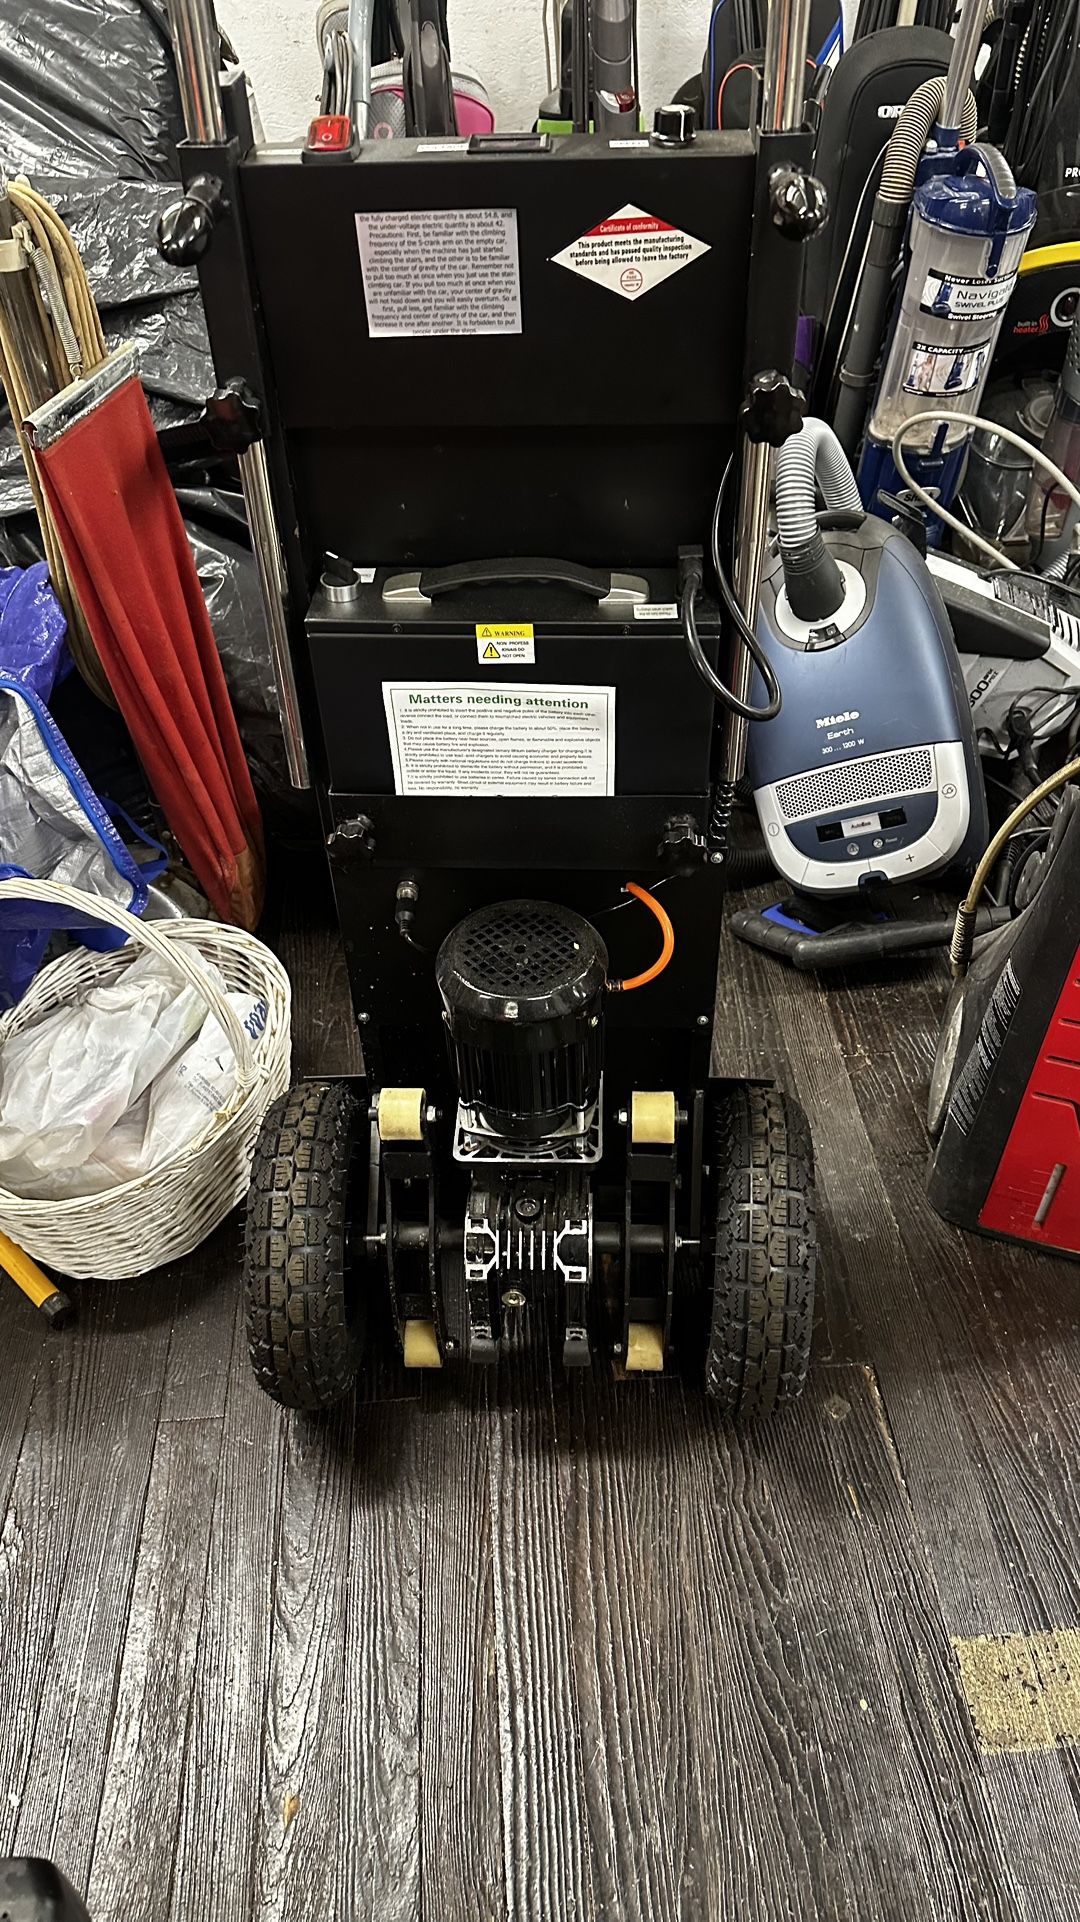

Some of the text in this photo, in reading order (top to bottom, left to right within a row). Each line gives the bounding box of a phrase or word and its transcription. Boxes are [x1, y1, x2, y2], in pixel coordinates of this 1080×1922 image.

[1065, 167, 1080, 178] PR
[384, 214, 409, 222] charged
[379, 222, 420, 230] under-voltage
[444, 221, 468, 229] quantity
[600, 224, 625, 233] Certificate
[633, 222, 658, 231] conformity
[481, 228, 505, 236] climbing
[368, 240, 397, 248] frequency
[591, 240, 612, 249] product
[644, 235, 684, 244] manufacturing
[374, 248, 401, 256] especially
[570, 250, 597, 258] standards
[622, 247, 641, 255] passed
[642, 246, 661, 254] quality
[663, 244, 692, 253] inspection
[575, 258, 593, 266] before
[595, 257, 610, 265] being
[612, 255, 633, 264] allowed
[423, 280, 434, 288] pull
[944, 275, 969, 284] Never
[480, 302, 504, 310] climbing
[987, 297, 1004, 306] PLUS
[371, 313, 399, 321] frequency
[469, 318, 495, 326] forbidden
[1013, 326, 1039, 334] heater
[928, 346, 964, 354] CAPACITY
[409, 694, 589, 709] Matters needing attention
[816, 711, 859, 728] Miele
[827, 728, 854, 739] Earth
[822, 746, 833, 754] 300
[842, 741, 855, 749] 1200
